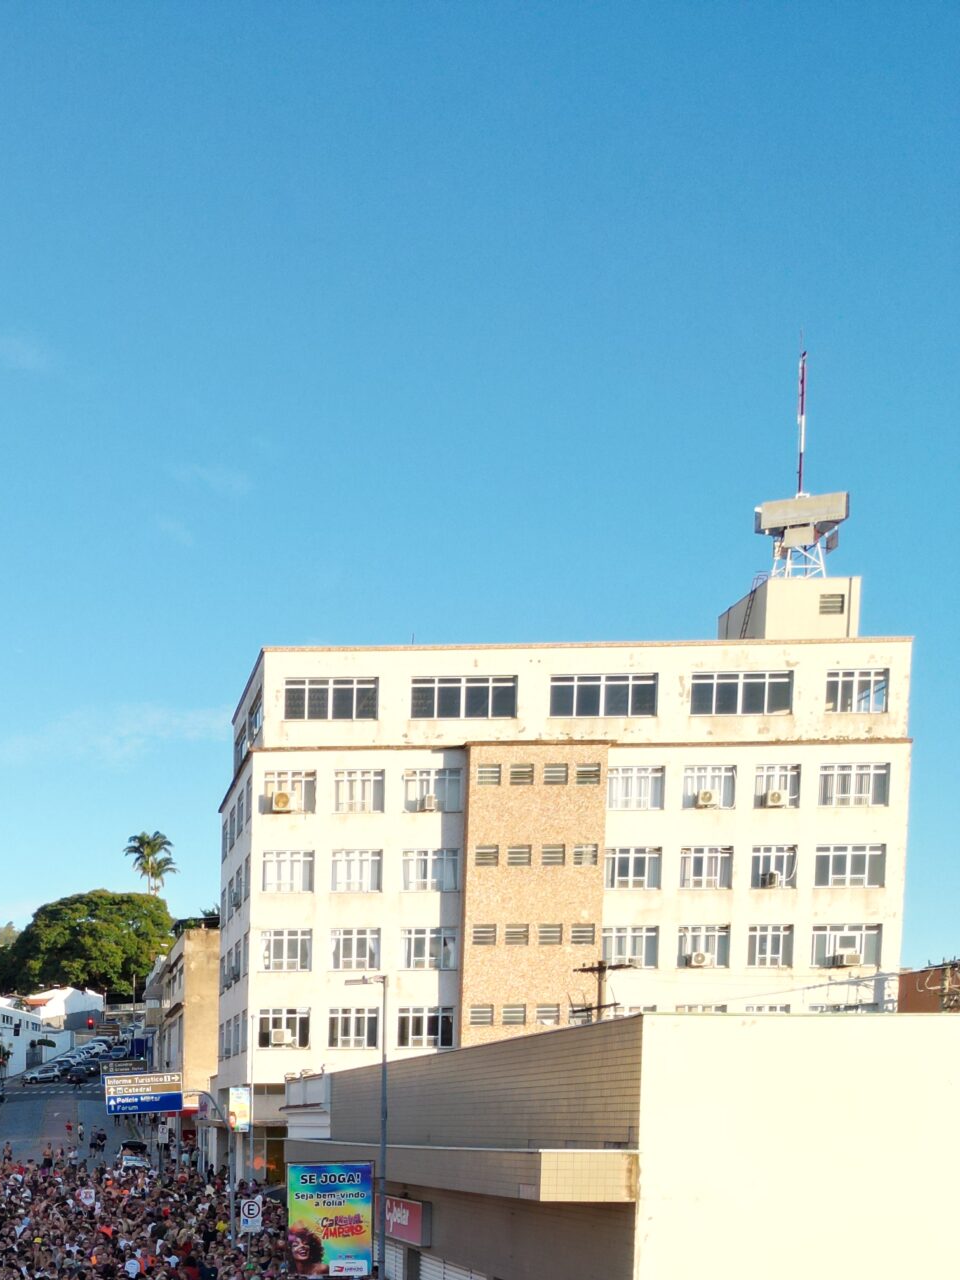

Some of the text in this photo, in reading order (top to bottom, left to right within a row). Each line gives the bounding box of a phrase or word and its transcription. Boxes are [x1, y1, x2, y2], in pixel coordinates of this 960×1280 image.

[300, 1173, 361, 1184] SE JOGA!
[295, 1191, 366, 1200] Seja bem-vindo
[247, 1203, 255, 1216] E
[385, 1199, 410, 1233] Cybelar
